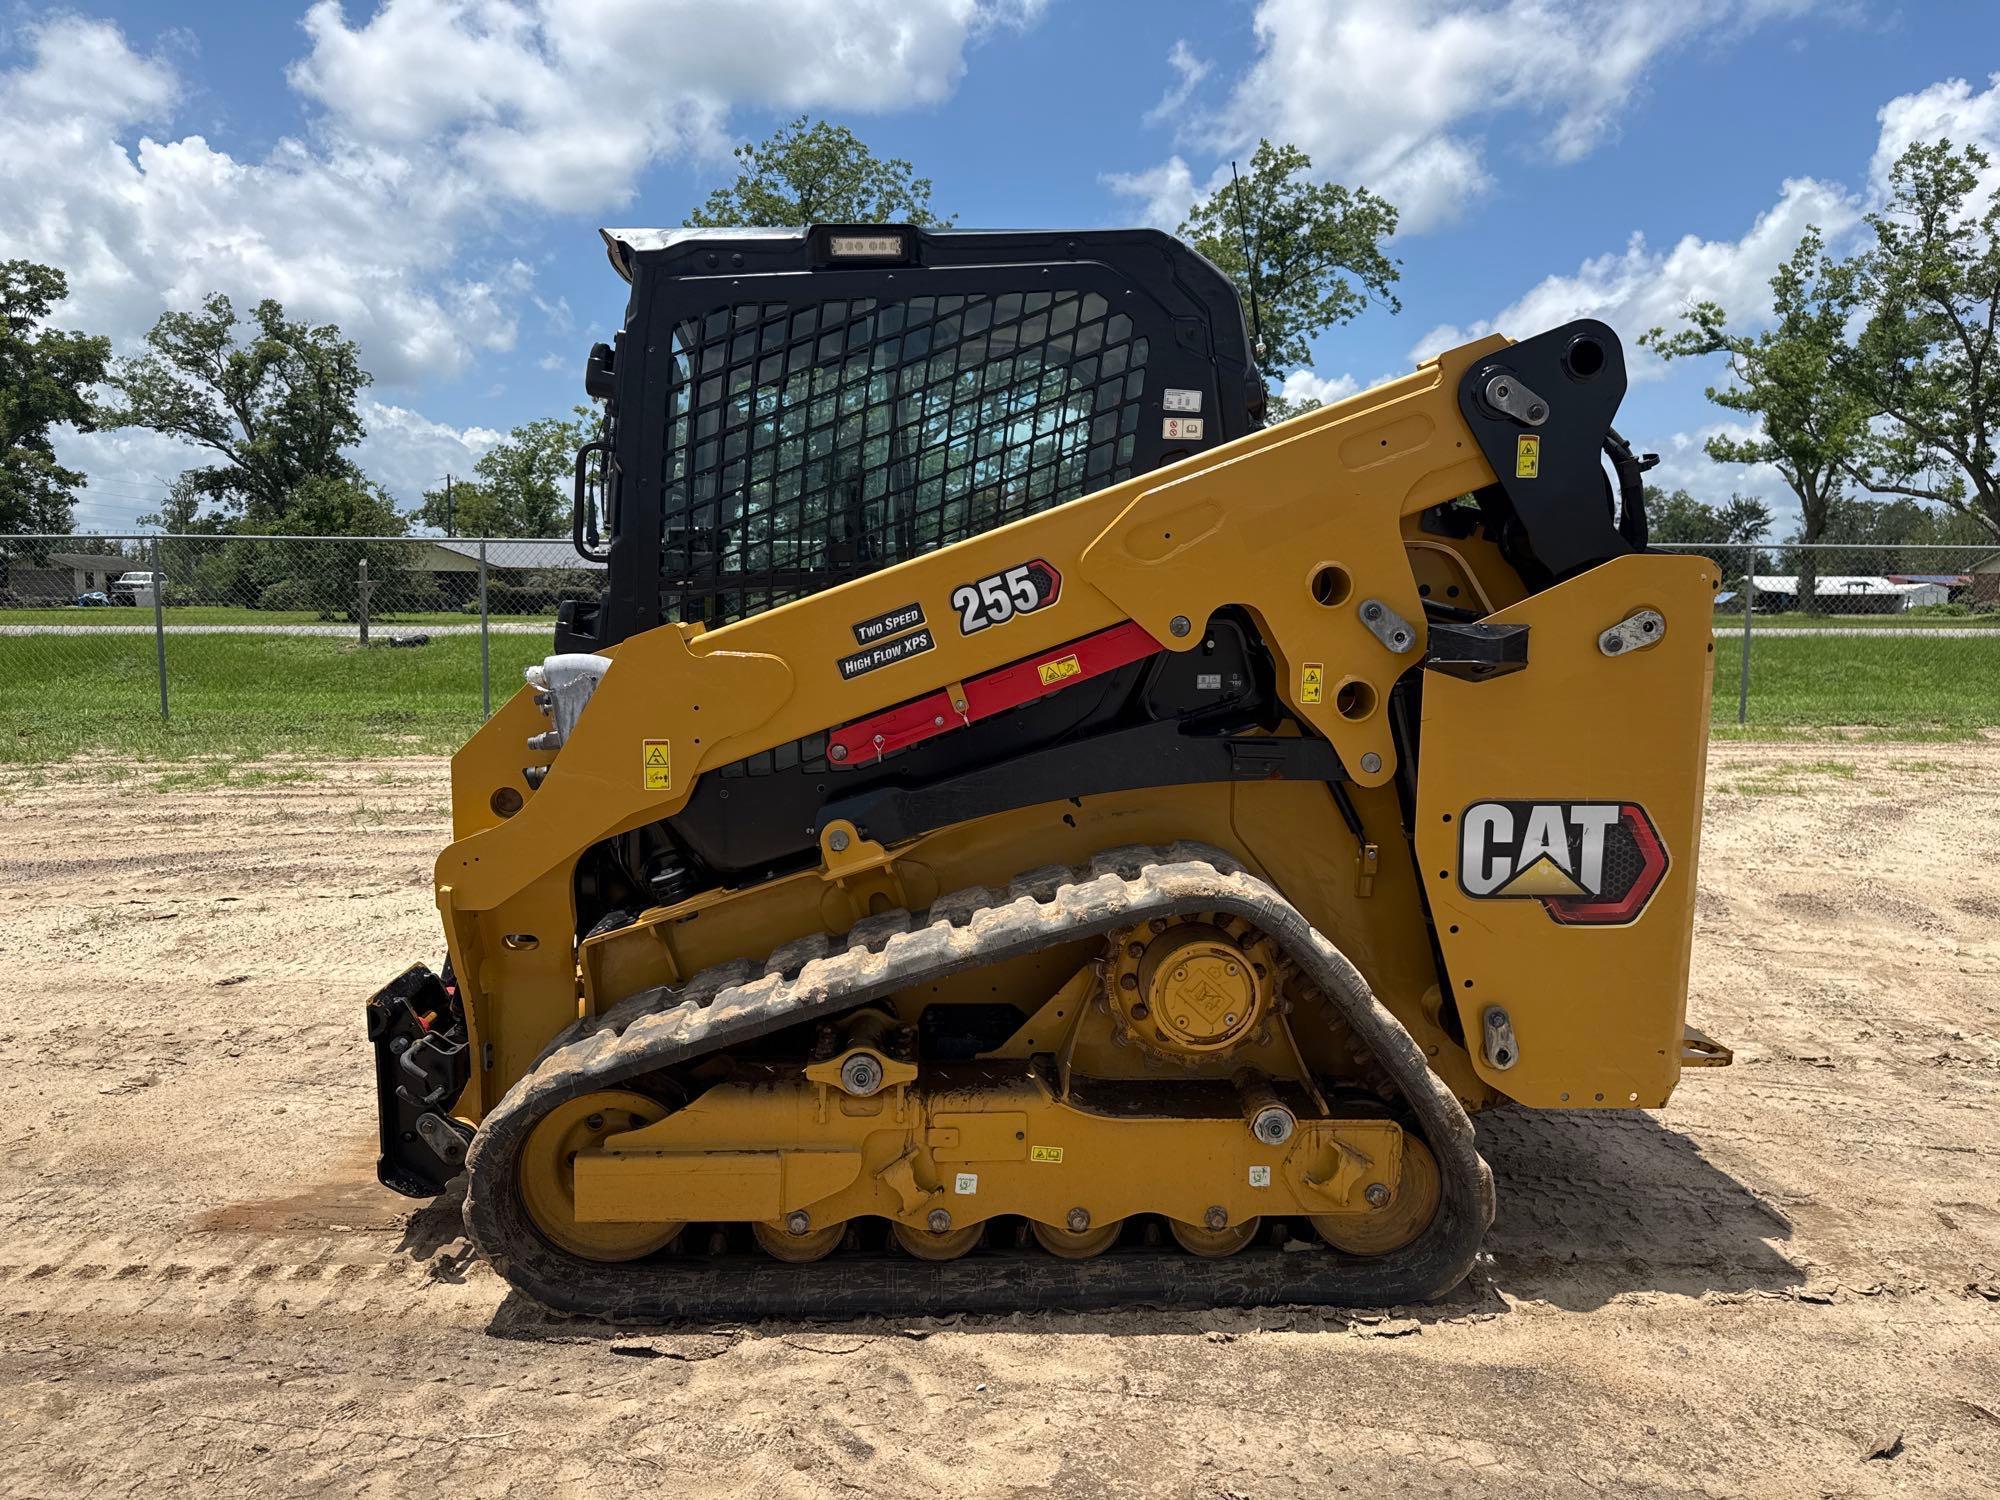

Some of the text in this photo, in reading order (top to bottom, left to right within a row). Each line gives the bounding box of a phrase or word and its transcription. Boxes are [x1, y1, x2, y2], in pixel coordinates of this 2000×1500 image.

[953, 566, 1039, 633] 255
[904, 634, 927, 652] XPS
[1462, 803, 1620, 895] CAT
